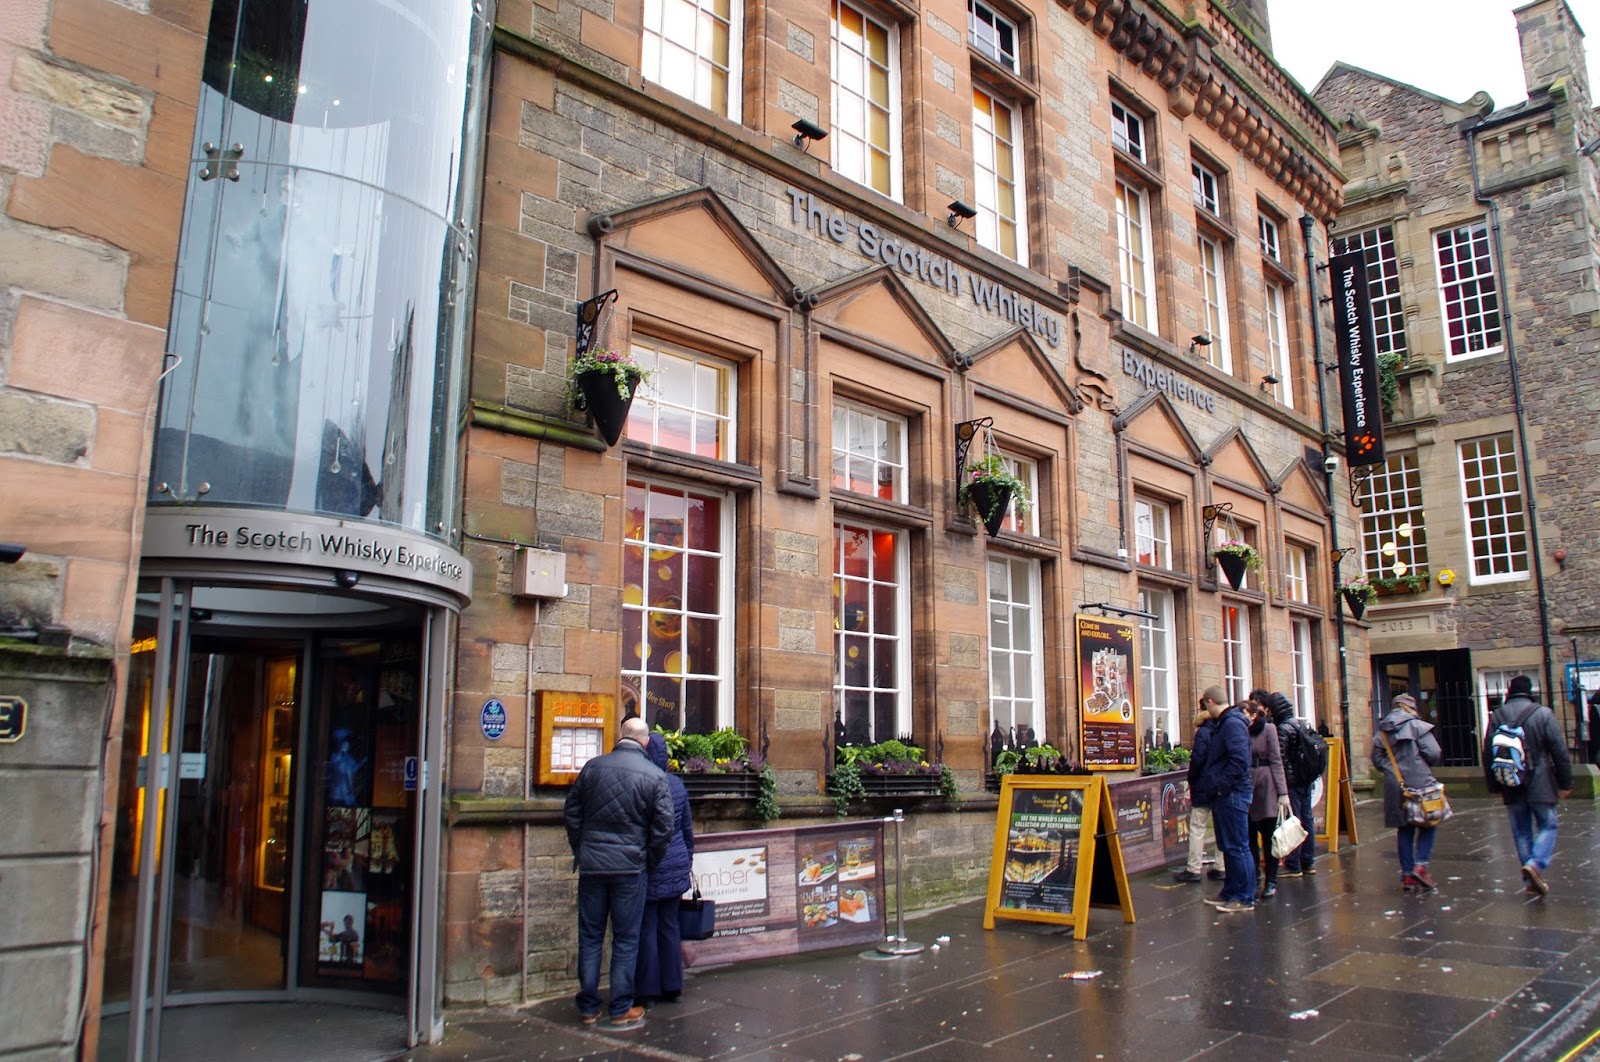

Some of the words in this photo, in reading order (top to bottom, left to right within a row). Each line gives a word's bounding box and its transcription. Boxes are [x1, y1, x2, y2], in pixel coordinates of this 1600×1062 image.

[1343, 266, 1354, 288] The
[786, 186, 848, 243] The
[858, 223, 963, 297] Scotch
[970, 272, 1061, 348] Whisky
[1122, 347, 1217, 413] Experience
[1345, 288, 1359, 325] Scotch
[1349, 325, 1362, 366] Whisky
[1352, 367, 1367, 428] Experience
[186, 524, 229, 546] The
[236, 526, 312, 551] Scotch
[318, 533, 392, 565] Whisky
[395, 545, 463, 580] Experience
[553, 698, 604, 716] amber
